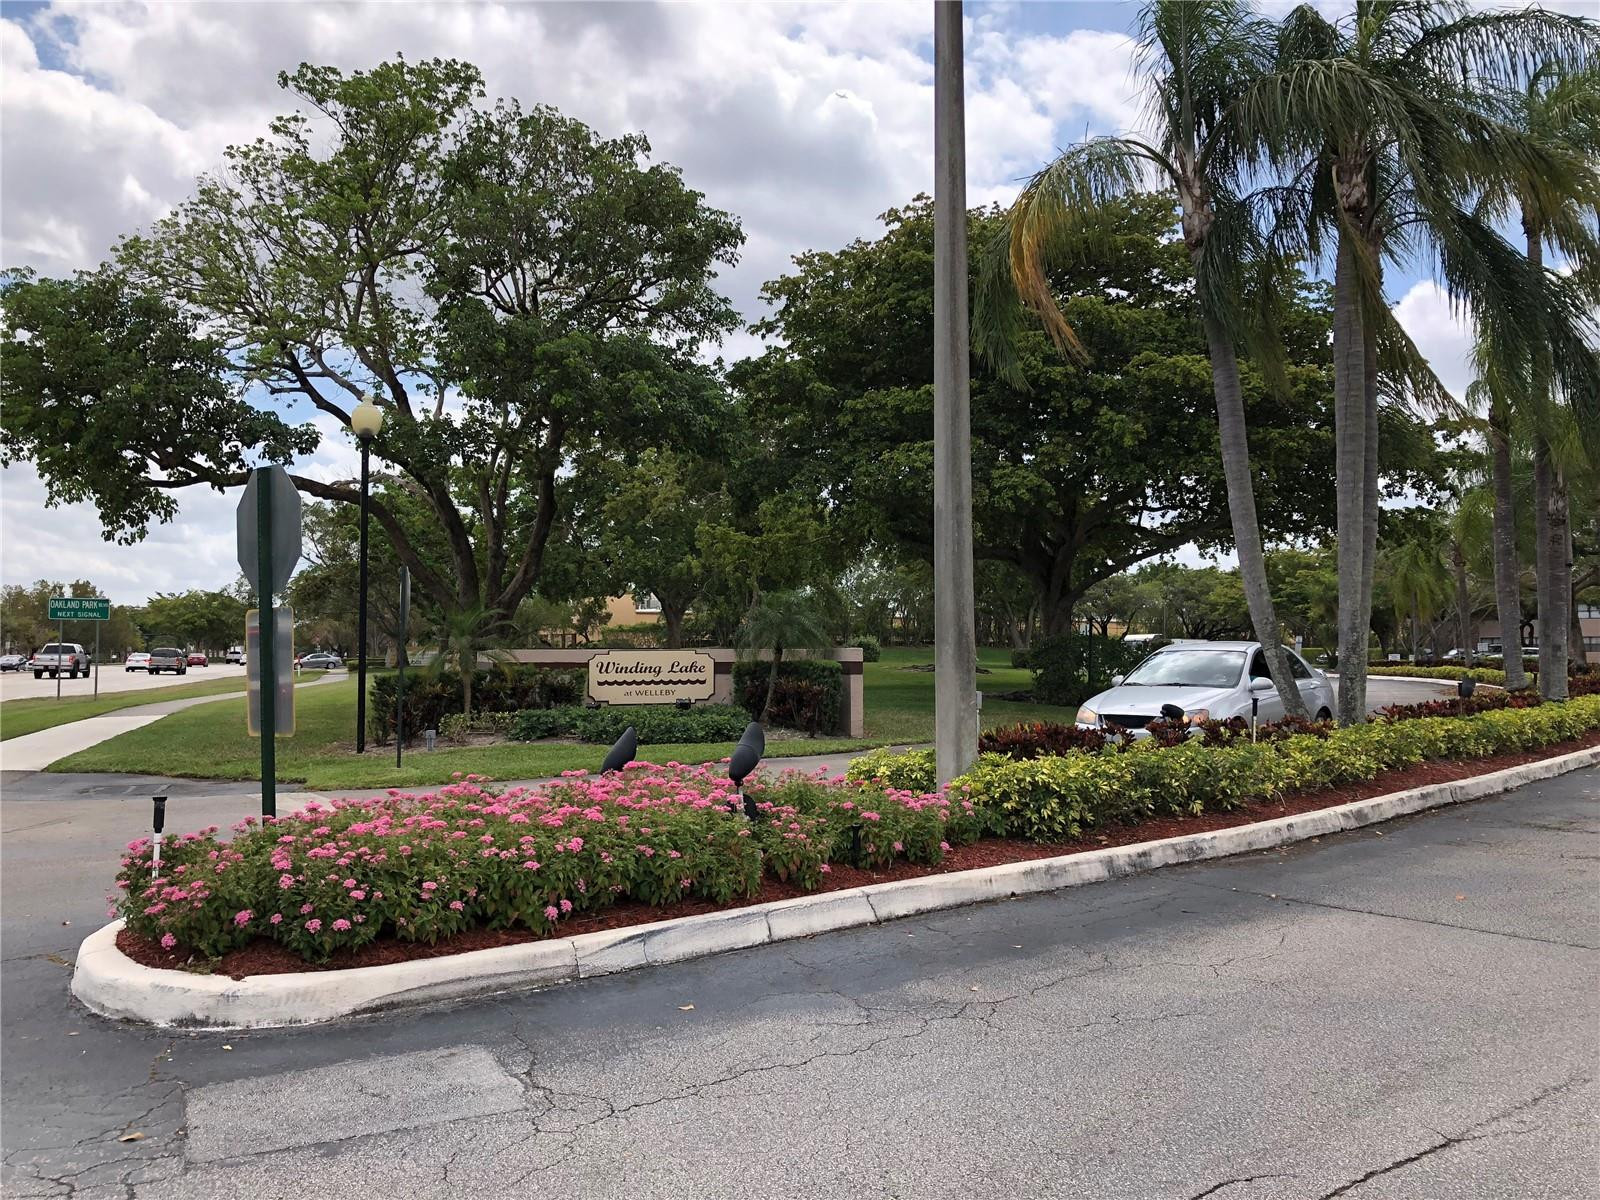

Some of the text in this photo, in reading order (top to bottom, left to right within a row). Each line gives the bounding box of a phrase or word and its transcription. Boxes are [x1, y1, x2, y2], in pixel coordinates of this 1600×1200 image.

[50, 600, 80, 609] OAKLAND
[82, 600, 98, 609] PARK
[596, 660, 706, 677] Winding Lake
[635, 689, 677, 697] WELLEBY
